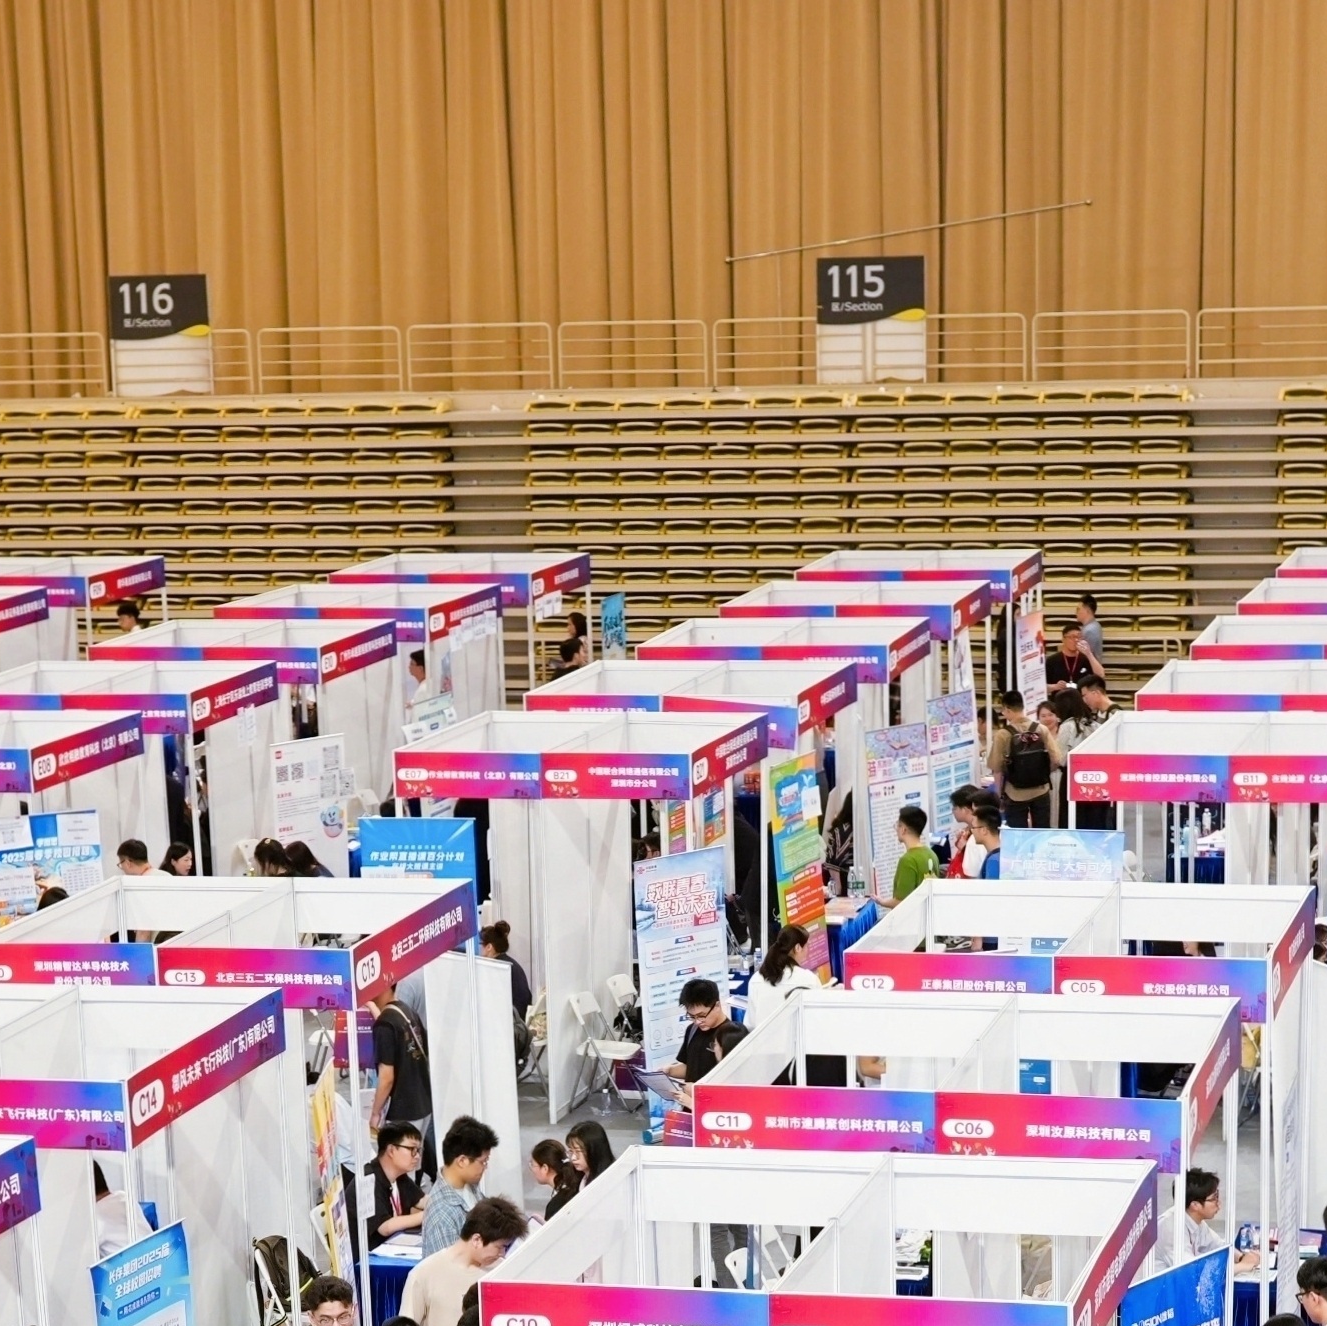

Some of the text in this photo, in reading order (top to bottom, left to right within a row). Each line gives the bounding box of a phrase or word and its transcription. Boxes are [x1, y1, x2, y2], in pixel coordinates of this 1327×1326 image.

[827, 264, 885, 298] 115
[118, 283, 173, 315] 116
[324, 656, 335, 672] E10
[195, 700, 208, 717] E09
[37, 757, 51, 775] E08
[404, 770, 423, 779] E07
[694, 761, 707, 780] B21
[552, 771, 571, 781] B21
[611, 779, 658, 789] 深圳市分公司
[1082, 773, 1101, 783] B20
[1243, 775, 1259, 784] B11
[646, 873, 707, 902] 数联青春
[656, 891, 717, 919] 智驭未来
[360, 904, 464, 985] C13 北京三五二环保科技有限公司
[34, 959, 129, 973] 深圳精智达半导体技术
[175, 971, 342, 986] C13 北京三五二环保科技有限公司
[860, 977, 1027, 993] C12 正泰集团股份有限公司
[1070, 982, 1230, 997] C05 歌尔股份有限公司
[138, 1015, 276, 1118] C14 御风未来飞行科技(广东)有限公司
[715, 1114, 923, 1135] C11 深圳市速腾聚创科技有限公司
[954, 1122, 984, 1136] C06
[108, 1241, 171, 1286] 长存集团2025届
[114, 1264, 162, 1300] 全球校园招聘
